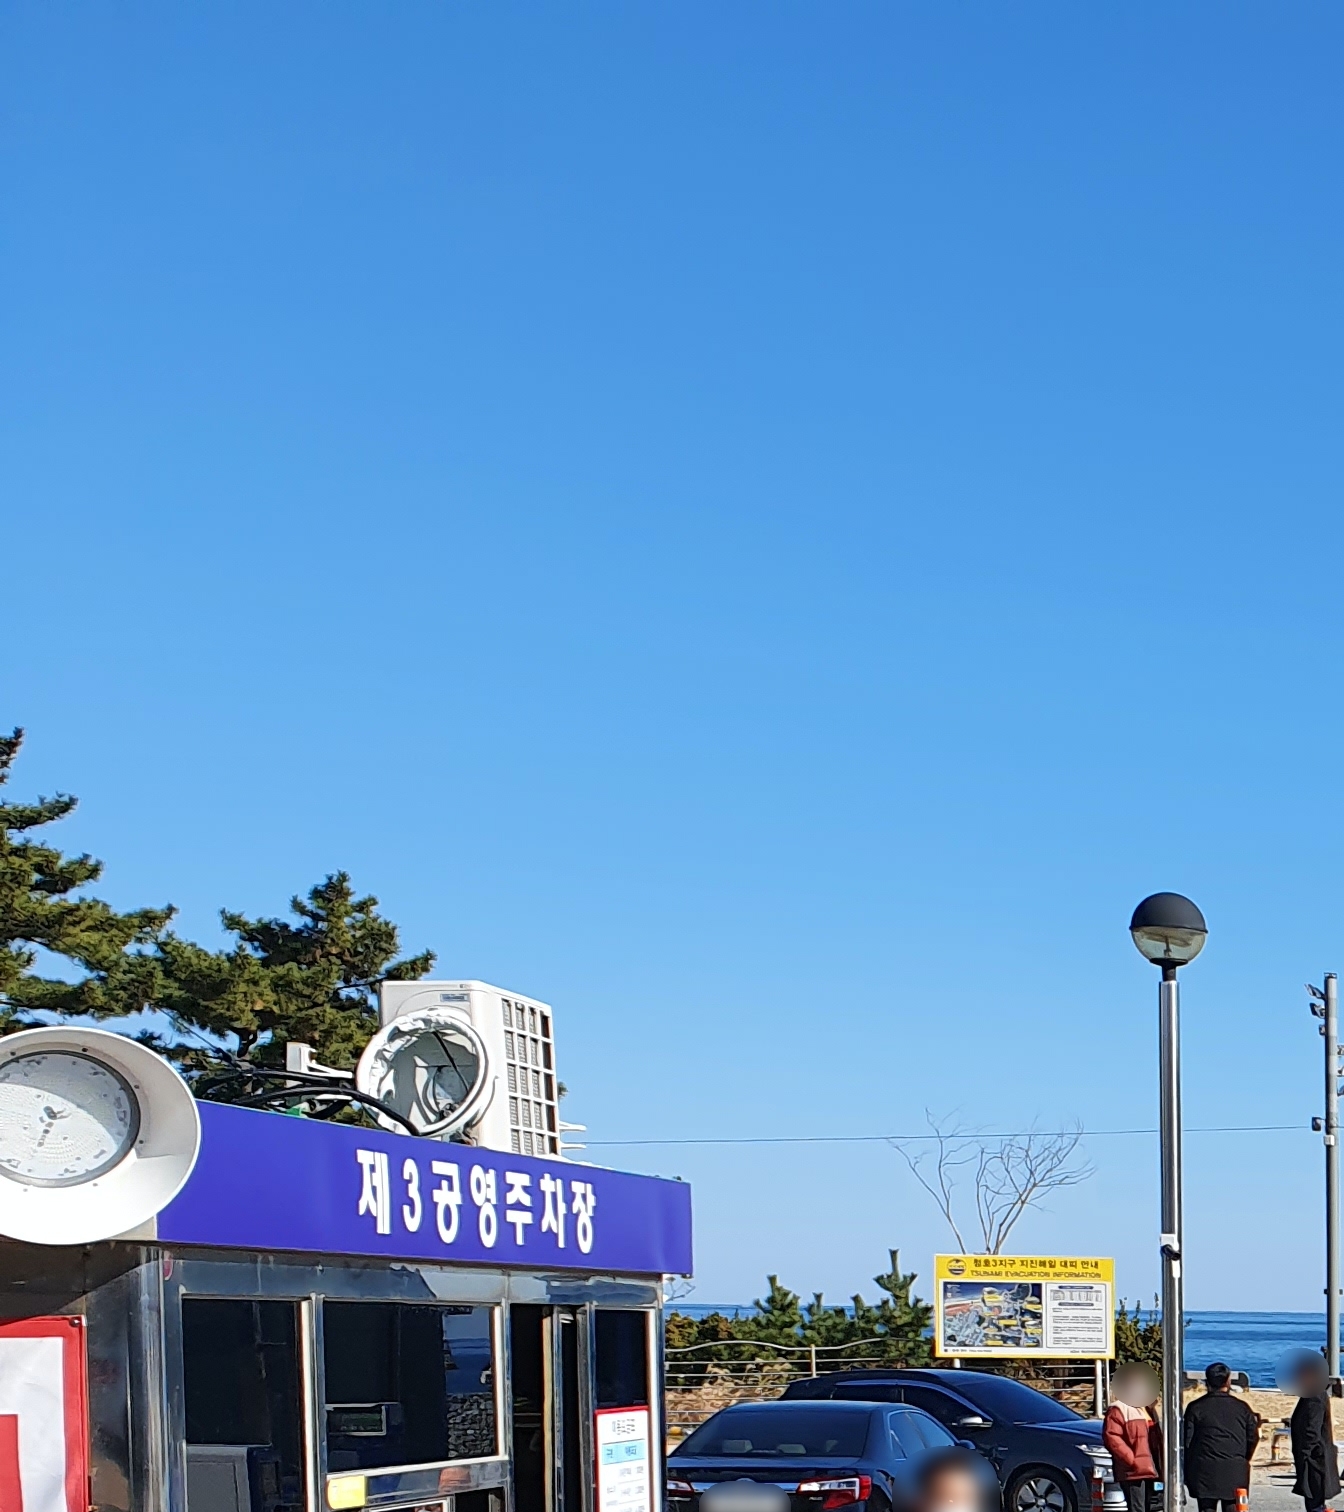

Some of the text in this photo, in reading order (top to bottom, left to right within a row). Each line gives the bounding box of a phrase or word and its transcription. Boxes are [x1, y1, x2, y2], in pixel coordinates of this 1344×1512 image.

[356, 1148, 597, 1254] 제3공영주차장
[1059, 1259, 1078, 1269] 대피
[970, 1270, 1102, 1279] TSUNAMI EVACUATION INFORMATION
